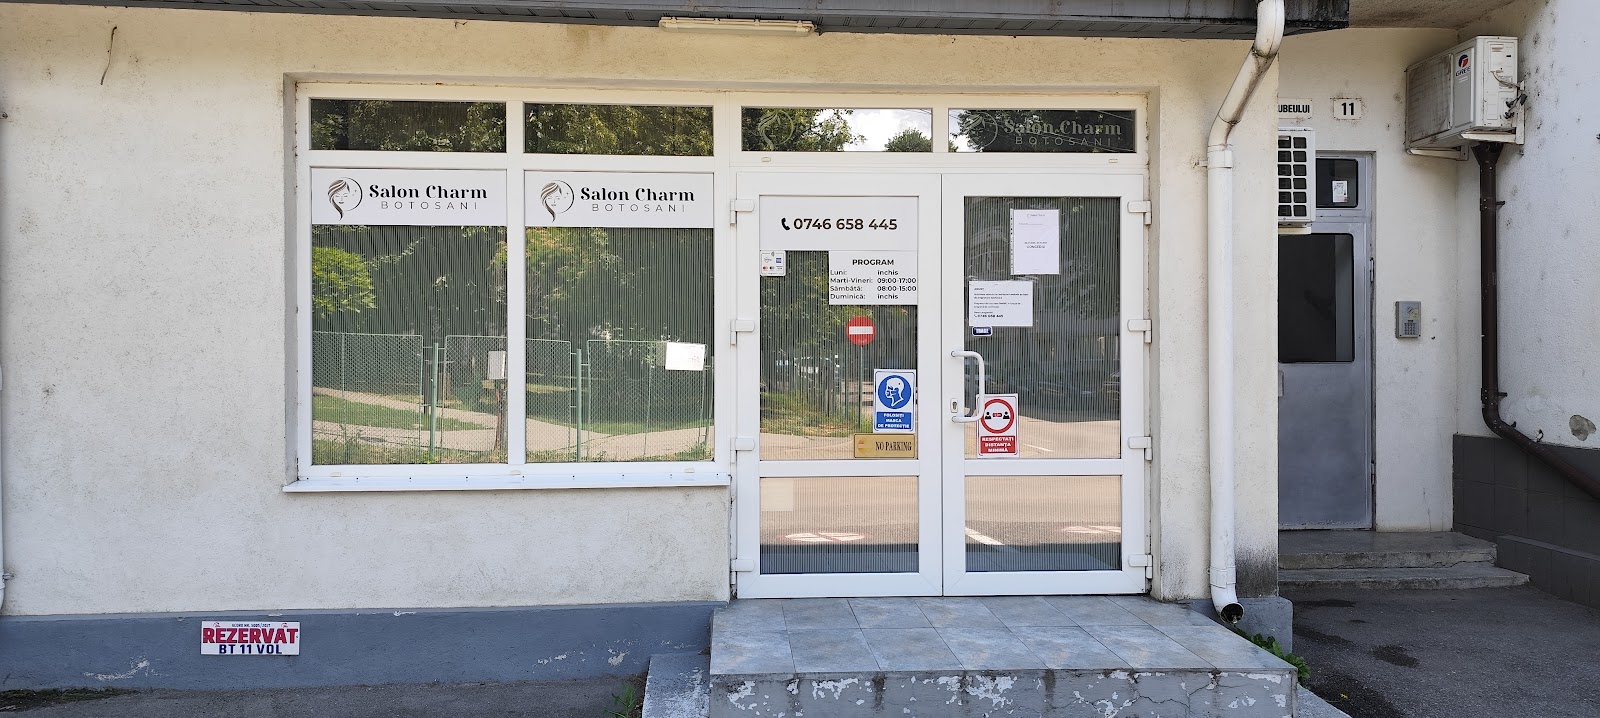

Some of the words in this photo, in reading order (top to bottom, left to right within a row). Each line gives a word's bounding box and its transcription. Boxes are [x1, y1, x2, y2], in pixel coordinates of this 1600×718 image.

[1341, 102, 1355, 116] 11
[1003, 119, 1054, 135] Salon
[1059, 120, 1122, 136] Charm
[1015, 137, 1112, 147] BOTOSANI
[369, 184, 419, 199] Salon
[426, 185, 488, 199] Charm
[580, 187, 630, 201] Salon
[635, 187, 695, 202] Charm
[381, 201, 477, 210] BOTOSANI
[592, 203, 686, 212] BOTOSANI
[793, 218, 832, 230] 0746
[836, 218, 864, 230] 658
[868, 218, 898, 230] 445
[875, 441, 884, 451] NO
[885, 441, 912, 451] PARKING
[203, 628, 298, 643] REZERVAT
[219, 644, 236, 654] BT
[239, 644, 252, 654] 11
[256, 644, 283, 654] VOL
